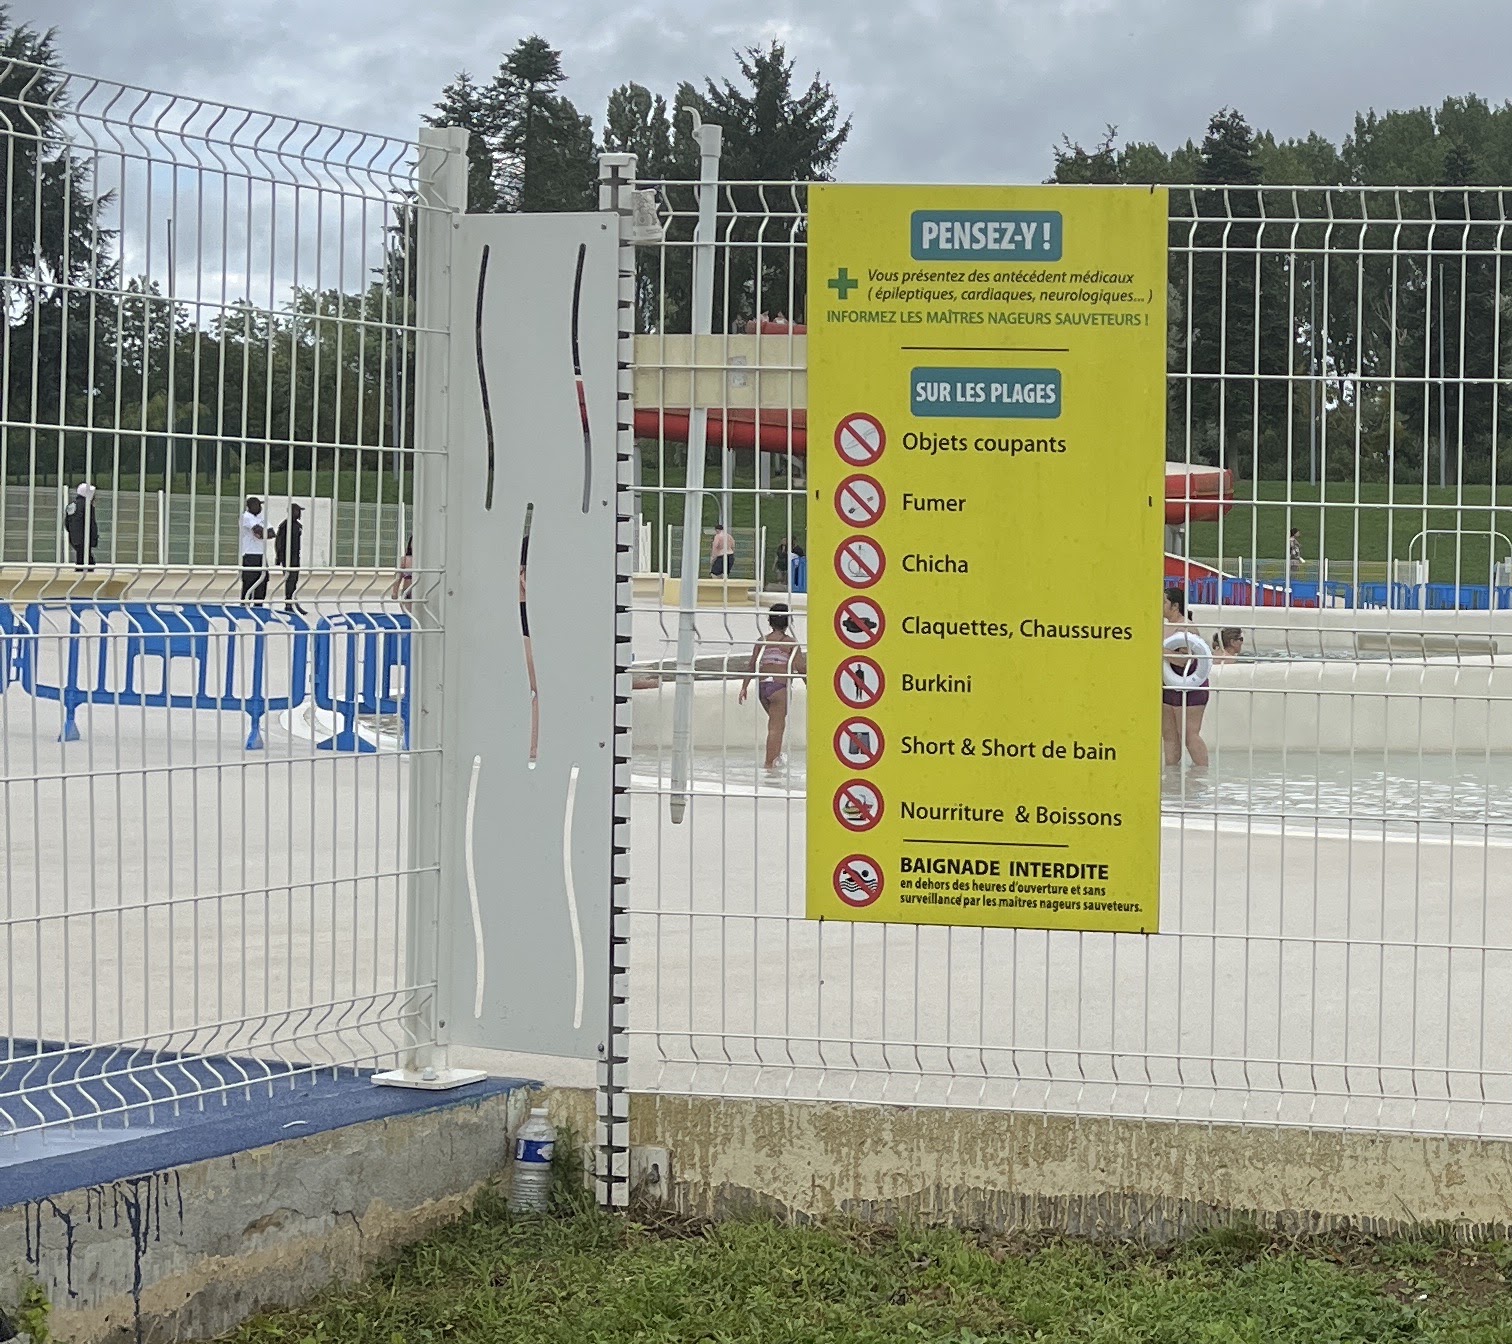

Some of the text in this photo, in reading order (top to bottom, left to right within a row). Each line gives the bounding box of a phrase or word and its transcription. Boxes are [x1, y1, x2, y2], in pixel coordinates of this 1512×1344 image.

[922, 221, 1052, 251] PENSEZ-Y !
[868, 268, 1135, 286] Vous présentez des antécédent médicaux
[875, 287, 957, 303] épileptiques,
[960, 287, 1036, 304] cardiaques,
[827, 310, 897, 324] INFORMEZ
[900, 311, 922, 324] LES
[926, 308, 984, 325] MAÎTRES
[988, 311, 1051, 325] NAGEURS
[1055, 312, 1142, 327] SAUVETEURS
[916, 382, 1056, 404] SUR LES PLAGES
[902, 432, 1067, 457] Objets coupants
[902, 493, 967, 512] Fumer
[902, 554, 969, 574] Chicha
[901, 616, 1133, 640] Claquettes, Chaussures
[901, 673, 973, 693] Burkini
[901, 736, 1117, 761] Short & Short de bain
[900, 801, 1123, 826] Nourriture & Boissons
[900, 857, 1109, 880] BAIGNADE INTERDITE
[900, 877, 1106, 897] en dehors des heures d'ouverture et sans
[963, 896, 980, 909] par
[982, 895, 997, 907] les
[1039, 898, 1081, 913] nageurs
[1083, 900, 1143, 913] sauveteurs.
